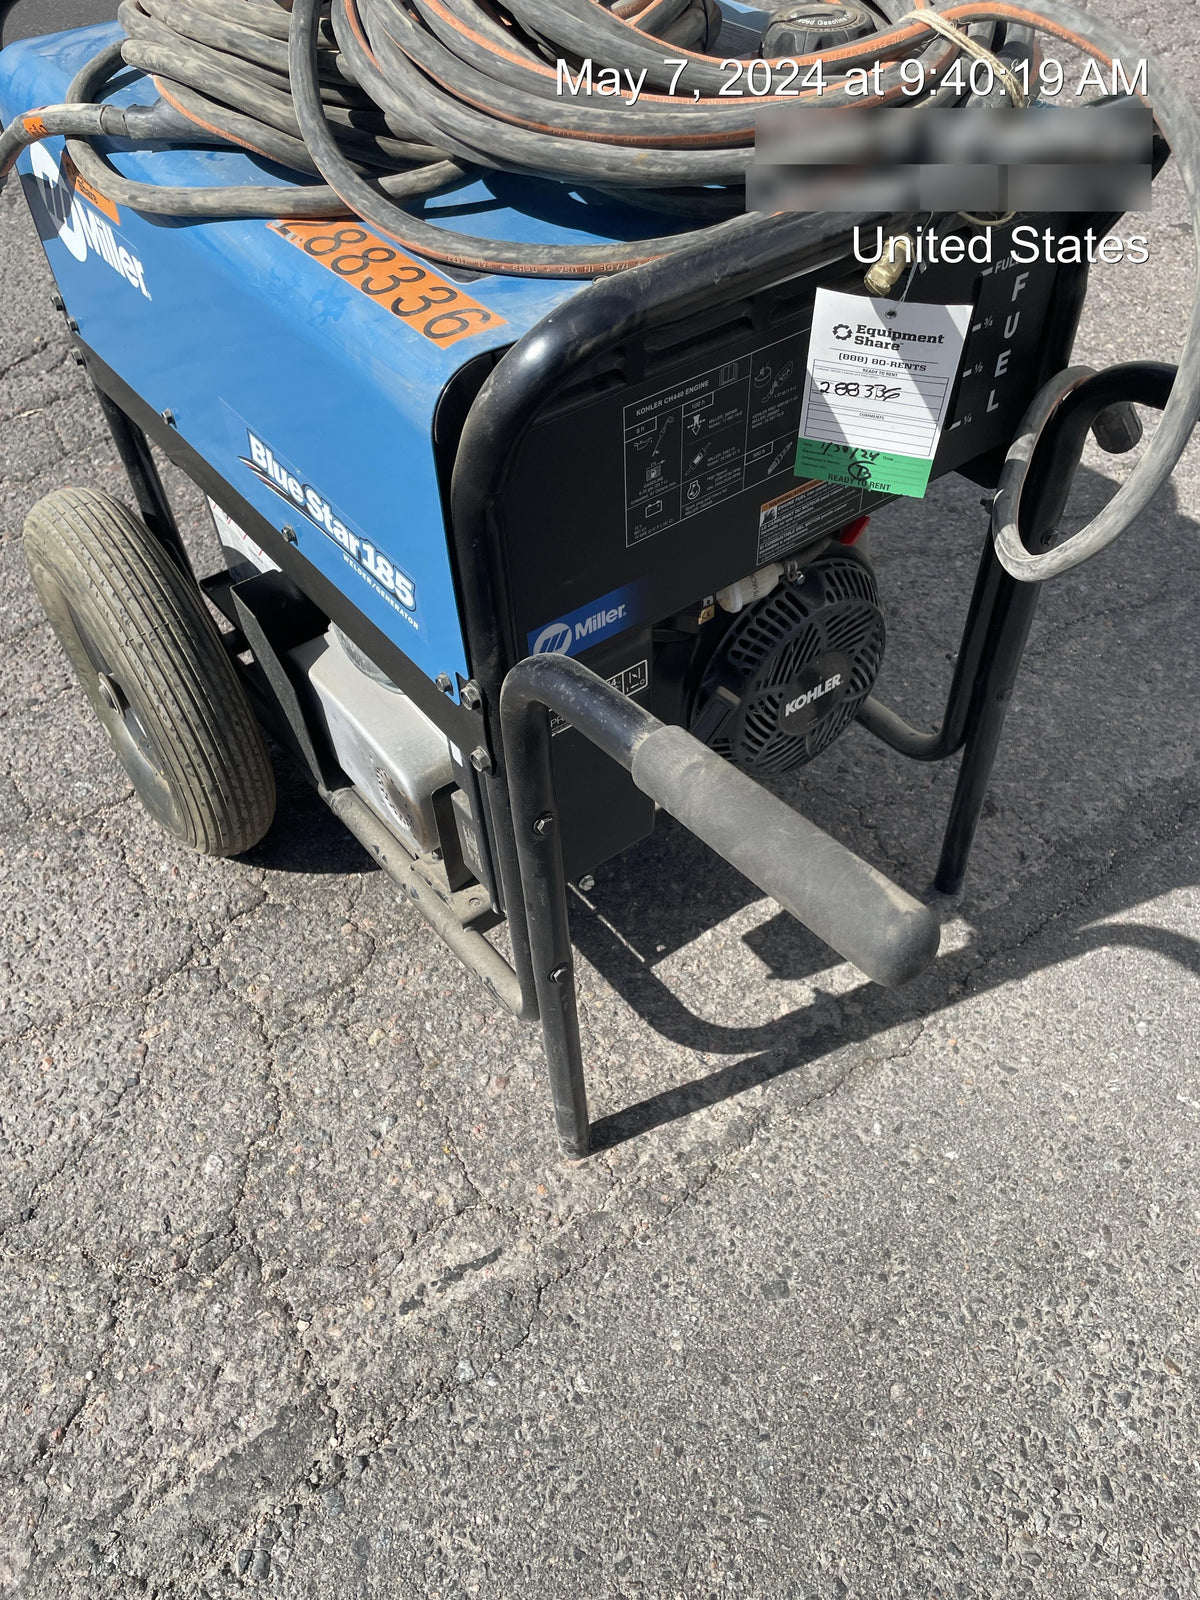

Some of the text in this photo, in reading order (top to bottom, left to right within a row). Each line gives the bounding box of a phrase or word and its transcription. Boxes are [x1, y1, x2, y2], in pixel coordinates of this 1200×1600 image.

[86, 208, 152, 301] Miller
[280, 221, 492, 340] 88336
[853, 335, 901, 351] Share
[855, 324, 945, 345] Equipment
[838, 352, 927, 372] (888) 80-RENTS
[635, 399, 663, 417] KOHLER
[685, 379, 710, 396] ENGINE
[827, 473, 854, 485] READY
[869, 481, 891, 491] RENT
[342, 553, 420, 632] WELDER/GENERATOR
[362, 541, 416, 610] 185
[575, 604, 627, 640] Miller
[785, 673, 843, 717] KOHLER
